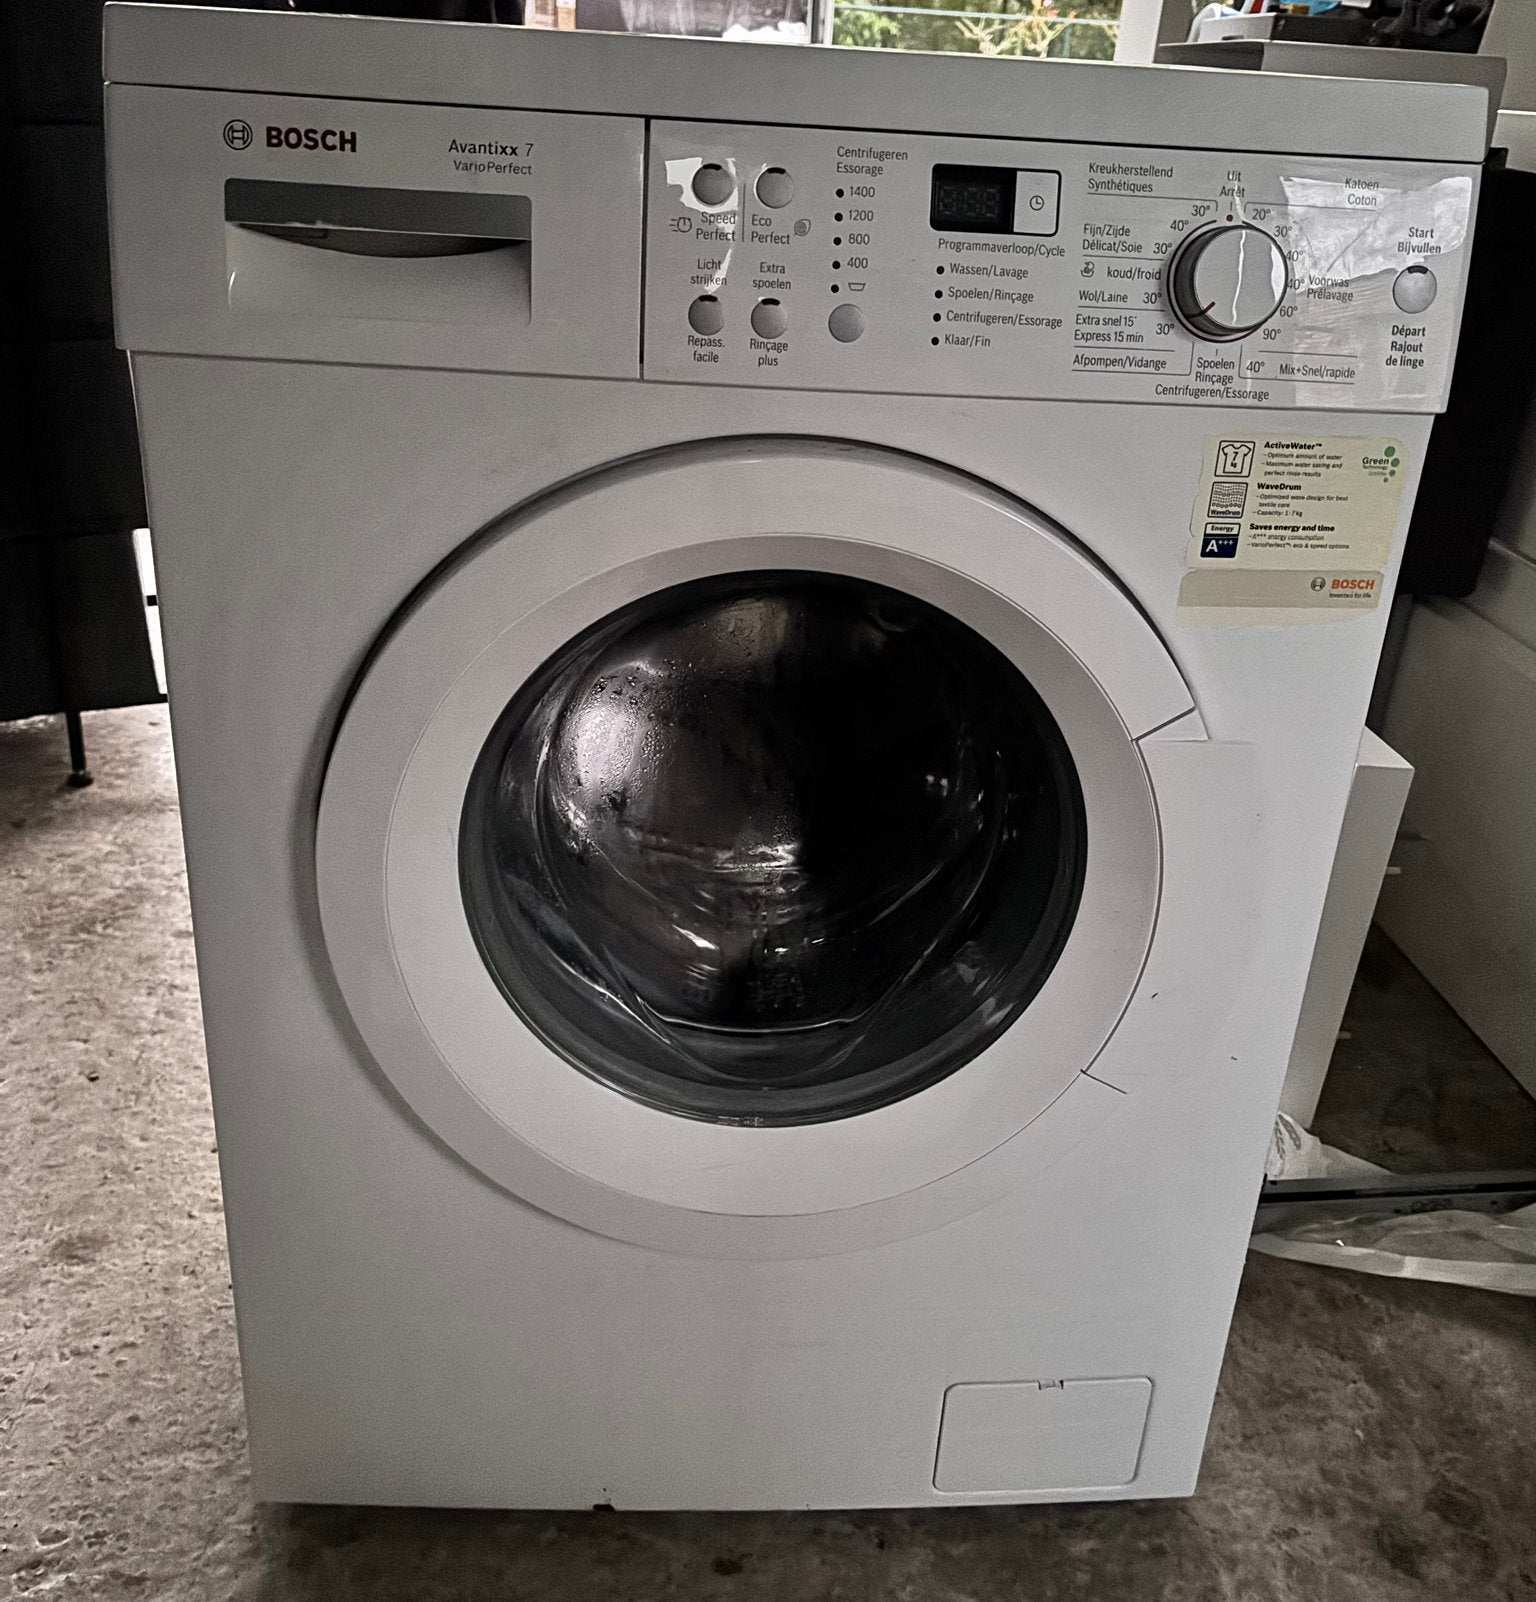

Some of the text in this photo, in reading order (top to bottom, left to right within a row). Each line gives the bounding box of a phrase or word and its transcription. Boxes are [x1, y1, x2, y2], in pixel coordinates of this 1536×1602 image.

[266, 126, 357, 153] BOSCH
[448, 138, 534, 157] Avantixx 7
[837, 146, 908, 162] Centrifugeren
[453, 159, 533, 176] VarioPerfect
[836, 162, 884, 177] Essorage
[1089, 162, 1173, 178] Kreukherstellend
[1227, 170, 1241, 182] Uit
[1088, 178, 1153, 194] Synthétiques
[1344, 177, 1379, 190] Katoen
[849, 186, 876, 198] 1400
[1219, 185, 1245, 198] Arrêt
[1347, 193, 1377, 206] Coton
[848, 210, 874, 222] 1200
[1191, 204, 1211, 217] 30°
[1251, 208, 1271, 221] 20°
[700, 211, 737, 226] Speed
[751, 214, 772, 227] Eco
[1170, 219, 1189, 231] 40°
[696, 228, 736, 242] Perfect
[1083, 223, 1131, 237] Fijn/Zijde
[1273, 225, 1293, 238] 30°
[1408, 226, 1434, 239] Start
[751, 231, 790, 245] Perfect
[848, 233, 870, 245] 800
[938, 238, 1066, 258] Programmaverloop/Cycle
[1082, 238, 1143, 254] Délicat/Soie
[1153, 242, 1173, 255] 30°
[1397, 241, 1441, 255] Bijvullen
[1285, 249, 1304, 262] 40°
[697, 258, 722, 271] Licht
[760, 261, 786, 274] Extra
[846, 257, 869, 269] 400
[950, 263, 1029, 280] Wassen/Lavage
[1107, 266, 1161, 280] koud/froid
[690, 274, 727, 288] strijken
[752, 277, 791, 291] spoelen
[1308, 274, 1349, 287] Voorwas
[948, 286, 1034, 304] Spoelen/Rinçage
[1079, 290, 1162, 304] Wol/Laine 30°
[1307, 287, 1353, 303] Prélavage
[1279, 306, 1298, 318] 60°
[946, 310, 1063, 330] Centrifugeren/Essorage
[1075, 314, 1101, 326] Extra
[1102, 315, 1122, 327] snel
[1074, 329, 1144, 343] Express 15 min
[1155, 323, 1175, 336] 30°
[1262, 328, 1281, 341] 90°
[1391, 324, 1426, 340] Départ
[688, 335, 725, 348] Repass.
[750, 338, 789, 354] Rinçage
[944, 333, 991, 348] Klaar/Fin
[1390, 340, 1423, 354] Rajout
[693, 350, 719, 363] facile
[758, 354, 778, 367] plus
[1073, 353, 1167, 371] Afpompen/Vidange
[1385, 355, 1424, 370] de linge
[1197, 357, 1235, 371] Spoelen
[1246, 361, 1356, 380] 40° Mix+Snel/rapide
[1195, 371, 1234, 386] Rinçage
[1155, 383, 1270, 402] Centrifugeren/Essorage
[1233, 451, 1239, 461] 7
[1362, 456, 1390, 465] Green
[1257, 482, 1302, 491] WaveDrum
[1211, 525, 1235, 533] Energy
[1249, 523, 1335, 533] Saves energy and time
[1331, 579, 1375, 590] BOSCH
